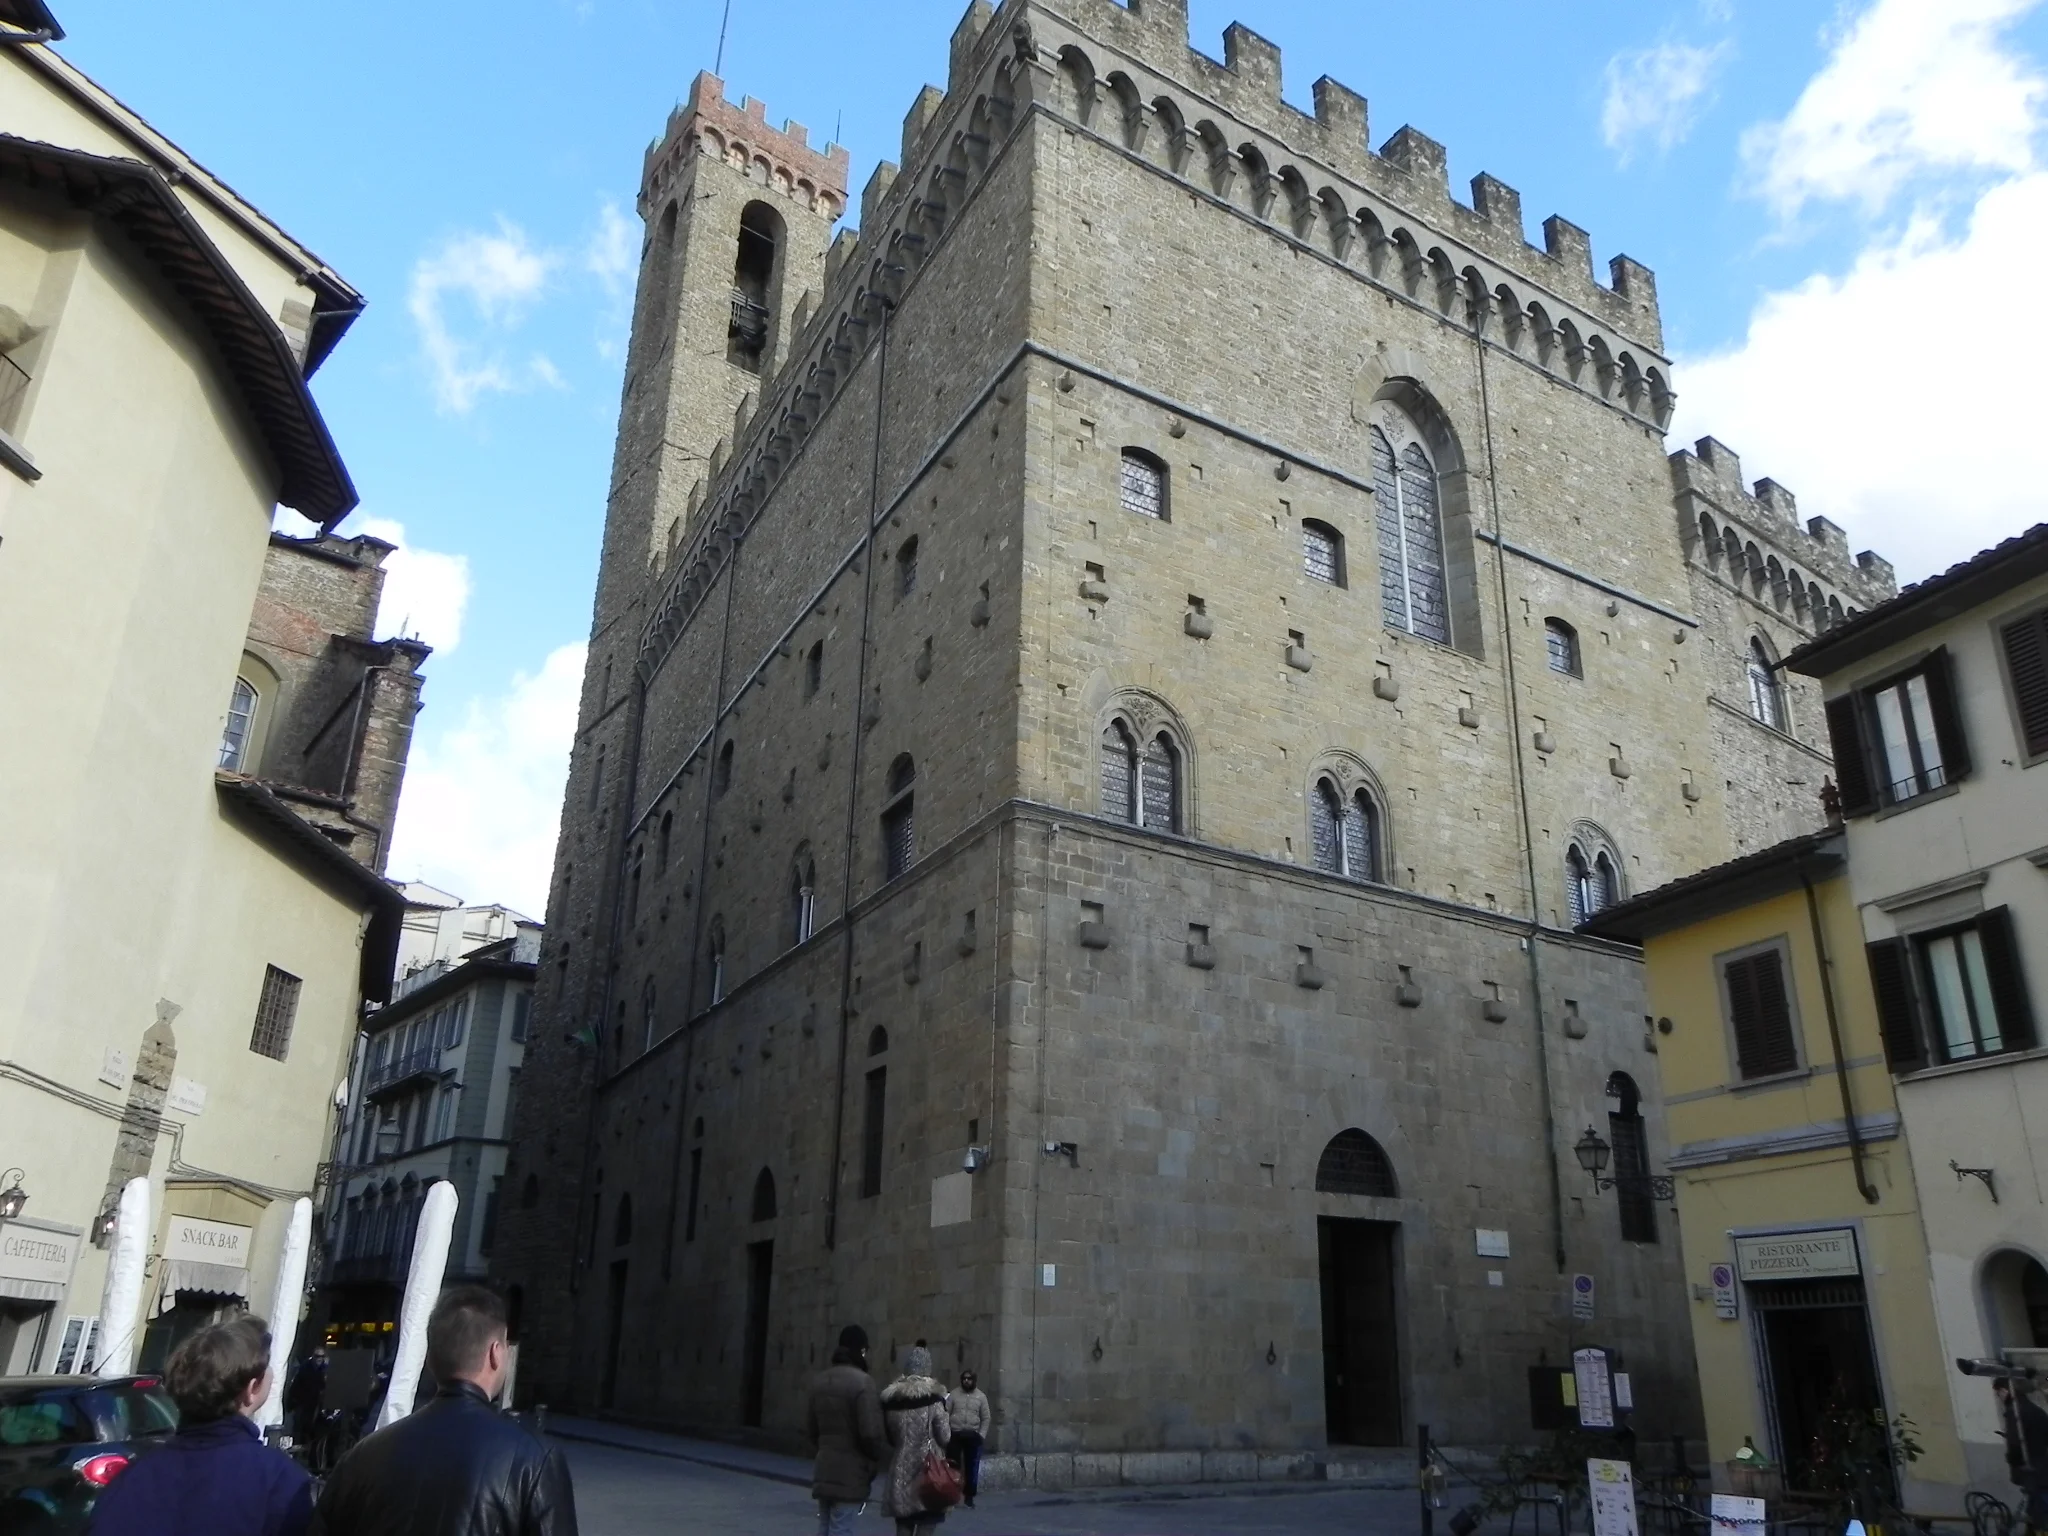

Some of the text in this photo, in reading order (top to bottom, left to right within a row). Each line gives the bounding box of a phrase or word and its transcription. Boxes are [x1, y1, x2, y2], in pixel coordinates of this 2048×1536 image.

[181, 1227, 239, 1250] SNACK BAR
[4, 1236, 67, 1264] CAFFETTERIA
[1758, 1241, 1841, 1257] RISTORANTE
[1750, 1257, 1810, 1270] PIZZERIA
